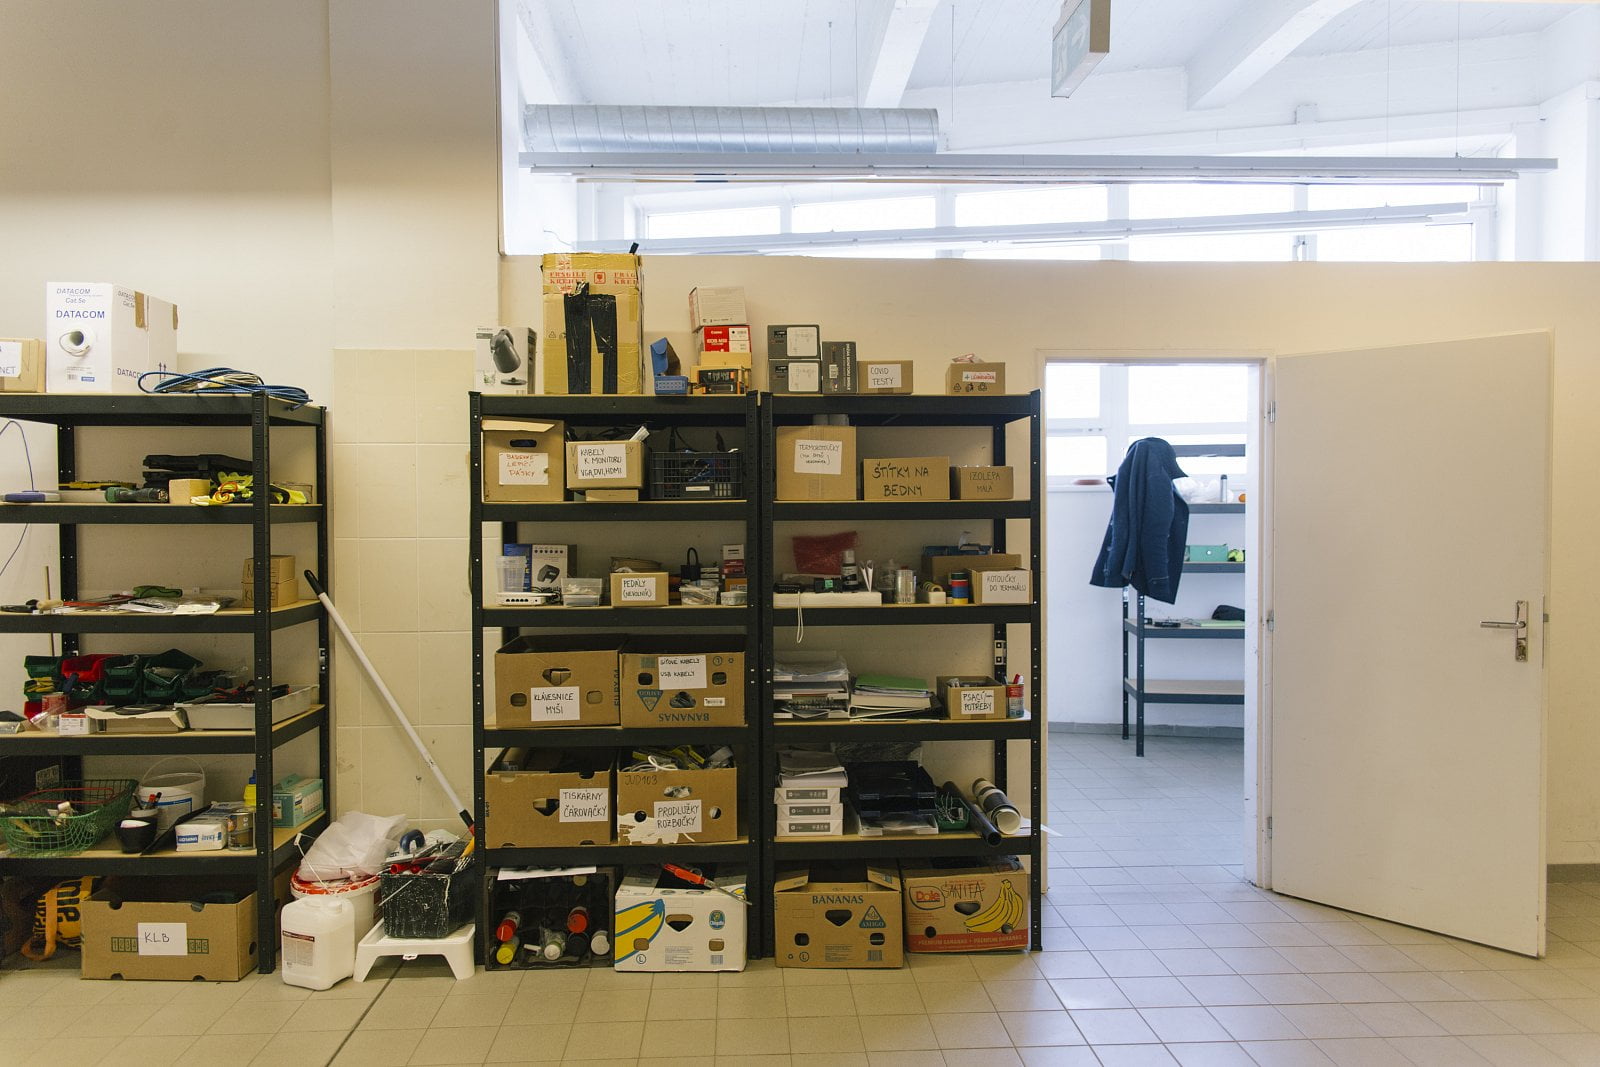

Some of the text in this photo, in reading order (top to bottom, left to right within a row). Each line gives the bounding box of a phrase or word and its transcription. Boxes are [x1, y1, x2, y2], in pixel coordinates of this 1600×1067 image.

[56, 287, 92, 295] DATACOM
[55, 310, 106, 319] DATACOM
[870, 367, 889, 375] COVID
[871, 377, 894, 386] TESTY
[580, 449, 605, 457] KABELY
[592, 456, 622, 464] MONITORU
[872, 462, 929, 479] ŠTÍTKY NA
[969, 471, 1001, 481] IZOLEPA
[883, 485, 923, 497] BEDNY
[623, 578, 646, 588] PEDÁLY
[989, 584, 998, 592] DO
[534, 691, 574, 701] KLÁVESNICE
[545, 703, 564, 714] MYŠI
[964, 701, 992, 712] POTŘEBY
[658, 713, 710, 721] BANANAS
[562, 789, 604, 801] TISKÁRNY
[657, 803, 700, 818] PRODLUŽKY
[656, 816, 697, 829] ROZBOČKY
[812, 895, 864, 904] BANANAS
[915, 890, 941, 901] Dole
[144, 931, 170, 944] KLB
